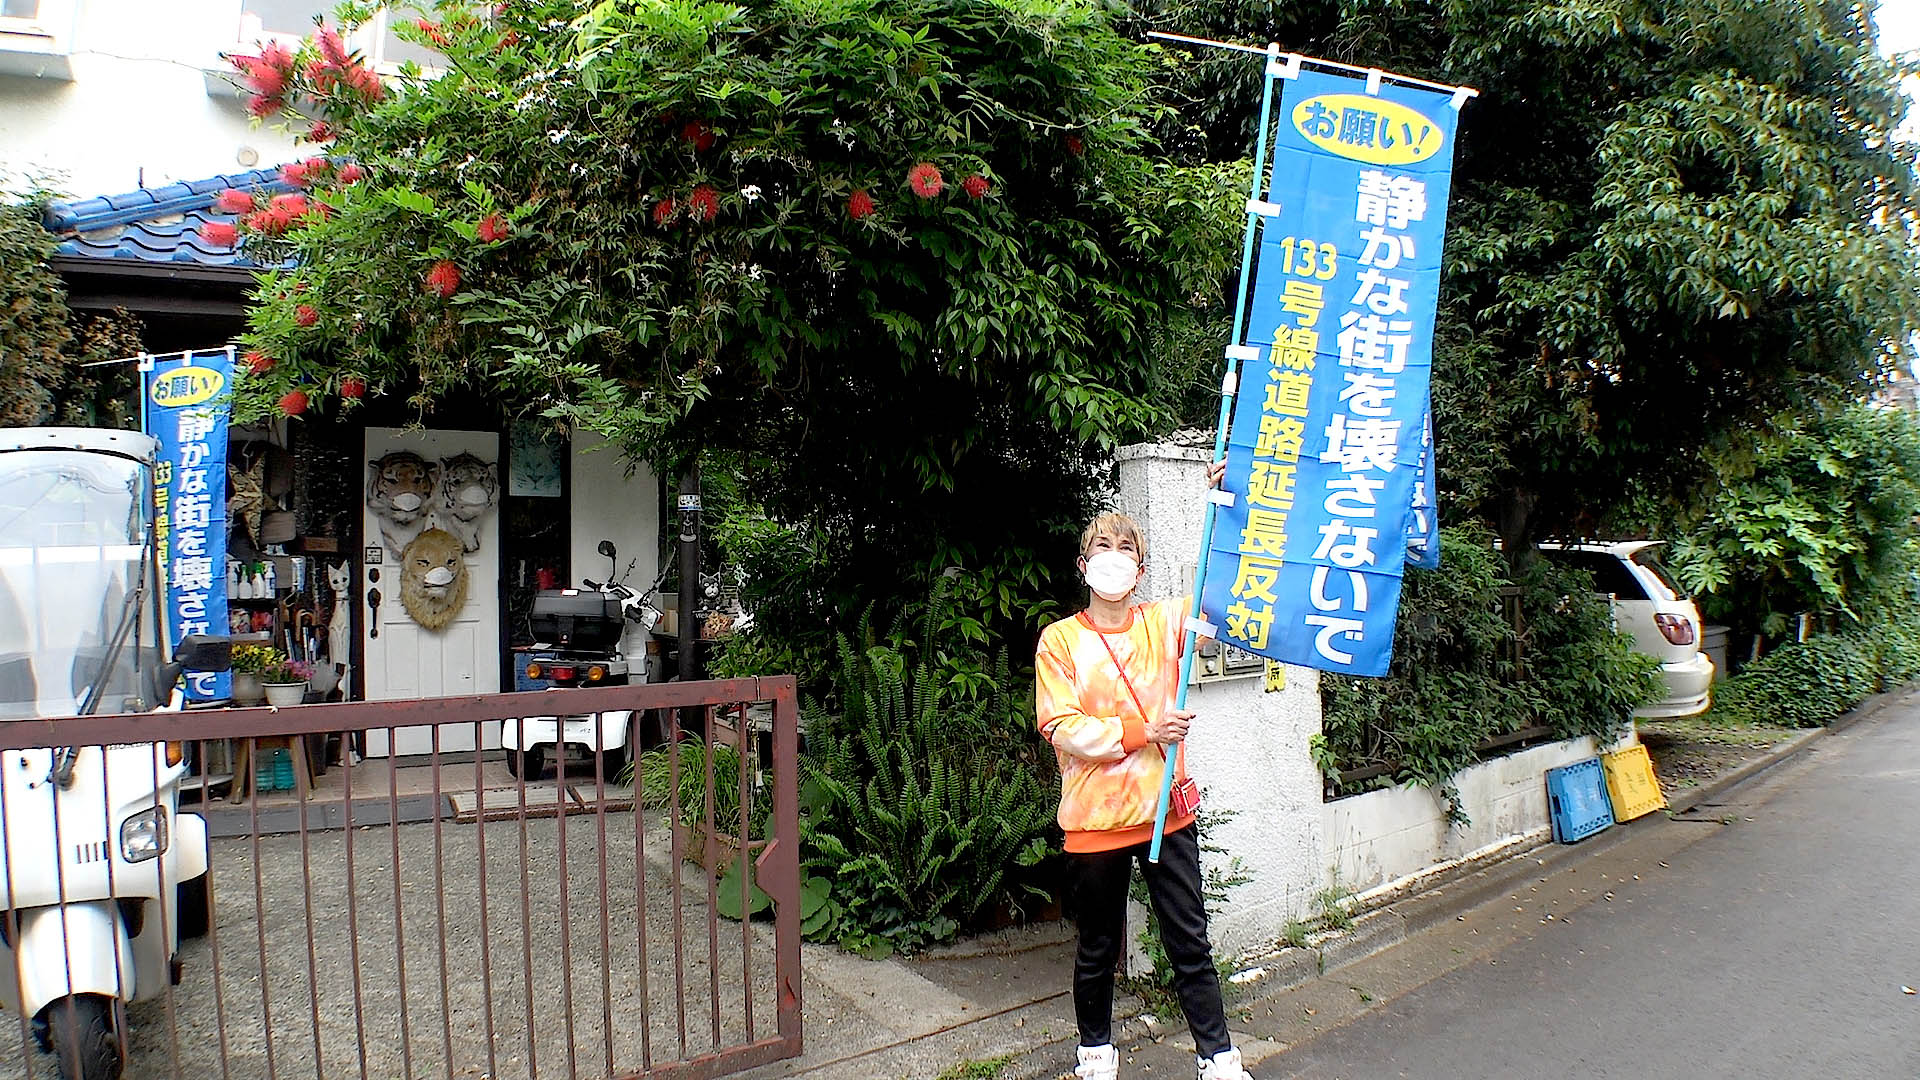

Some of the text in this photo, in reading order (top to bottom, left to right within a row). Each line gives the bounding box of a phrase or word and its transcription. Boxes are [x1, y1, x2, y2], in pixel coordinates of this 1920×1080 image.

[1301, 101, 1430, 155] お願い!
[154, 375, 218, 400] お願い!
[1225, 236, 1337, 650] 133号線道路延長反対
[1304, 170, 1427, 665] 静かな街を壊さないで
[173, 408, 217, 696] 静かな街を壊さなで
